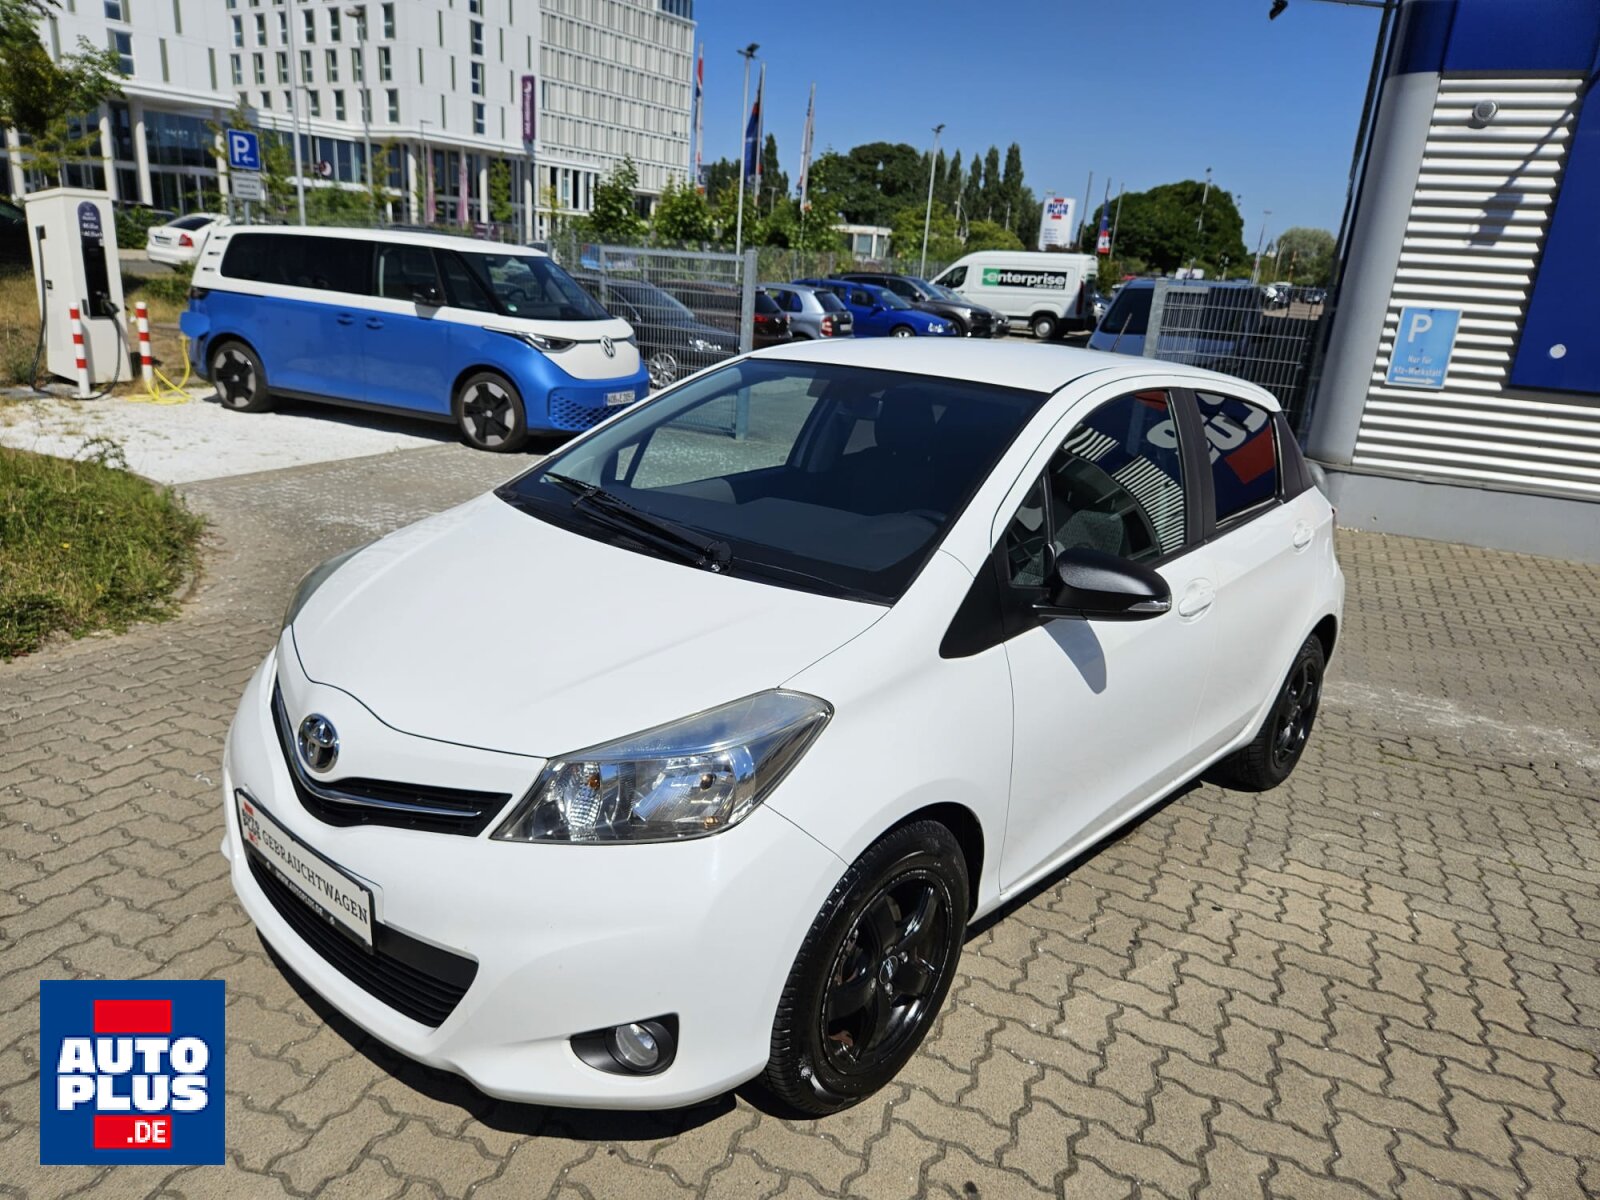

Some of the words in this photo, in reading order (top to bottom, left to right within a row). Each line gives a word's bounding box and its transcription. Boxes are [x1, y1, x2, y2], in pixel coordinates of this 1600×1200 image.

[232, 135, 250, 163] P
[985, 272, 1066, 287] enterprise
[1407, 313, 1433, 343] P
[1407, 354, 1420, 364] Nur
[262, 830, 368, 925] GEBRAUCHTWAGEN
